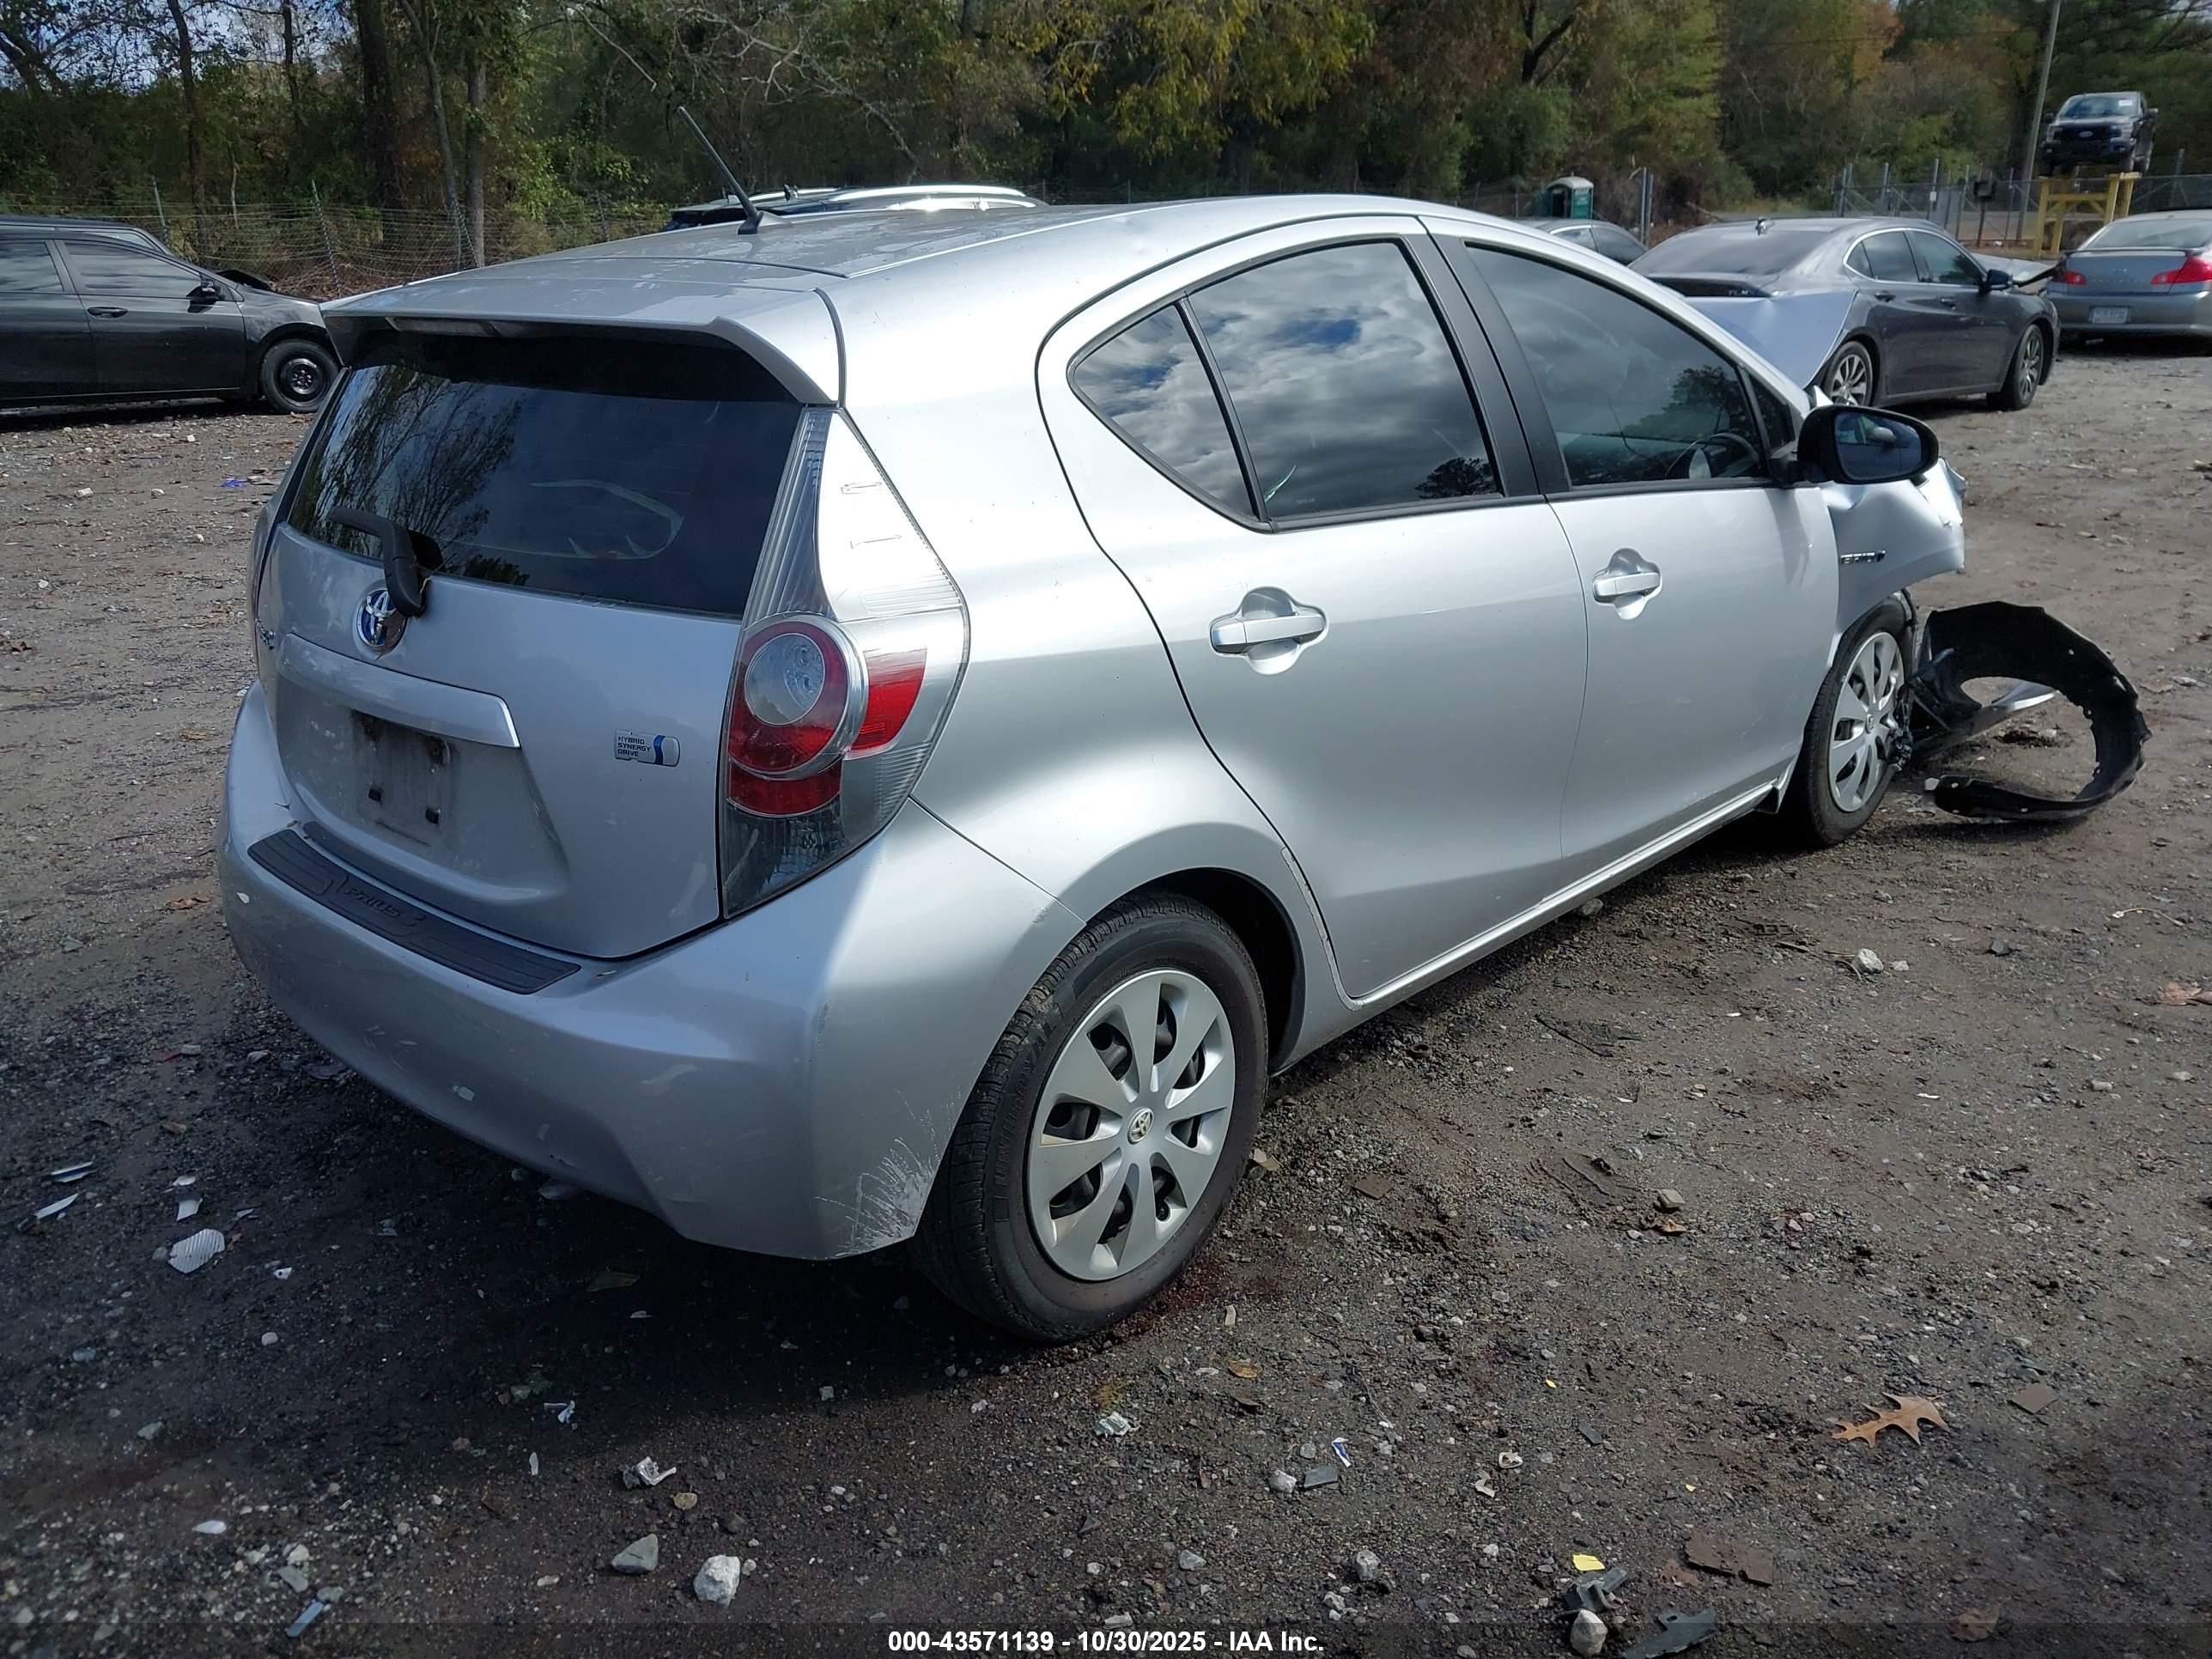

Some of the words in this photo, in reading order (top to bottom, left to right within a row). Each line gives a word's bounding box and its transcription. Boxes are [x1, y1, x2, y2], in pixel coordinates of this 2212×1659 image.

[617, 736, 646, 744] HYBRID
[617, 742, 651, 752] SYNERGY
[617, 749, 640, 757] DRIVE
[344, 887, 401, 918] PRIUS
